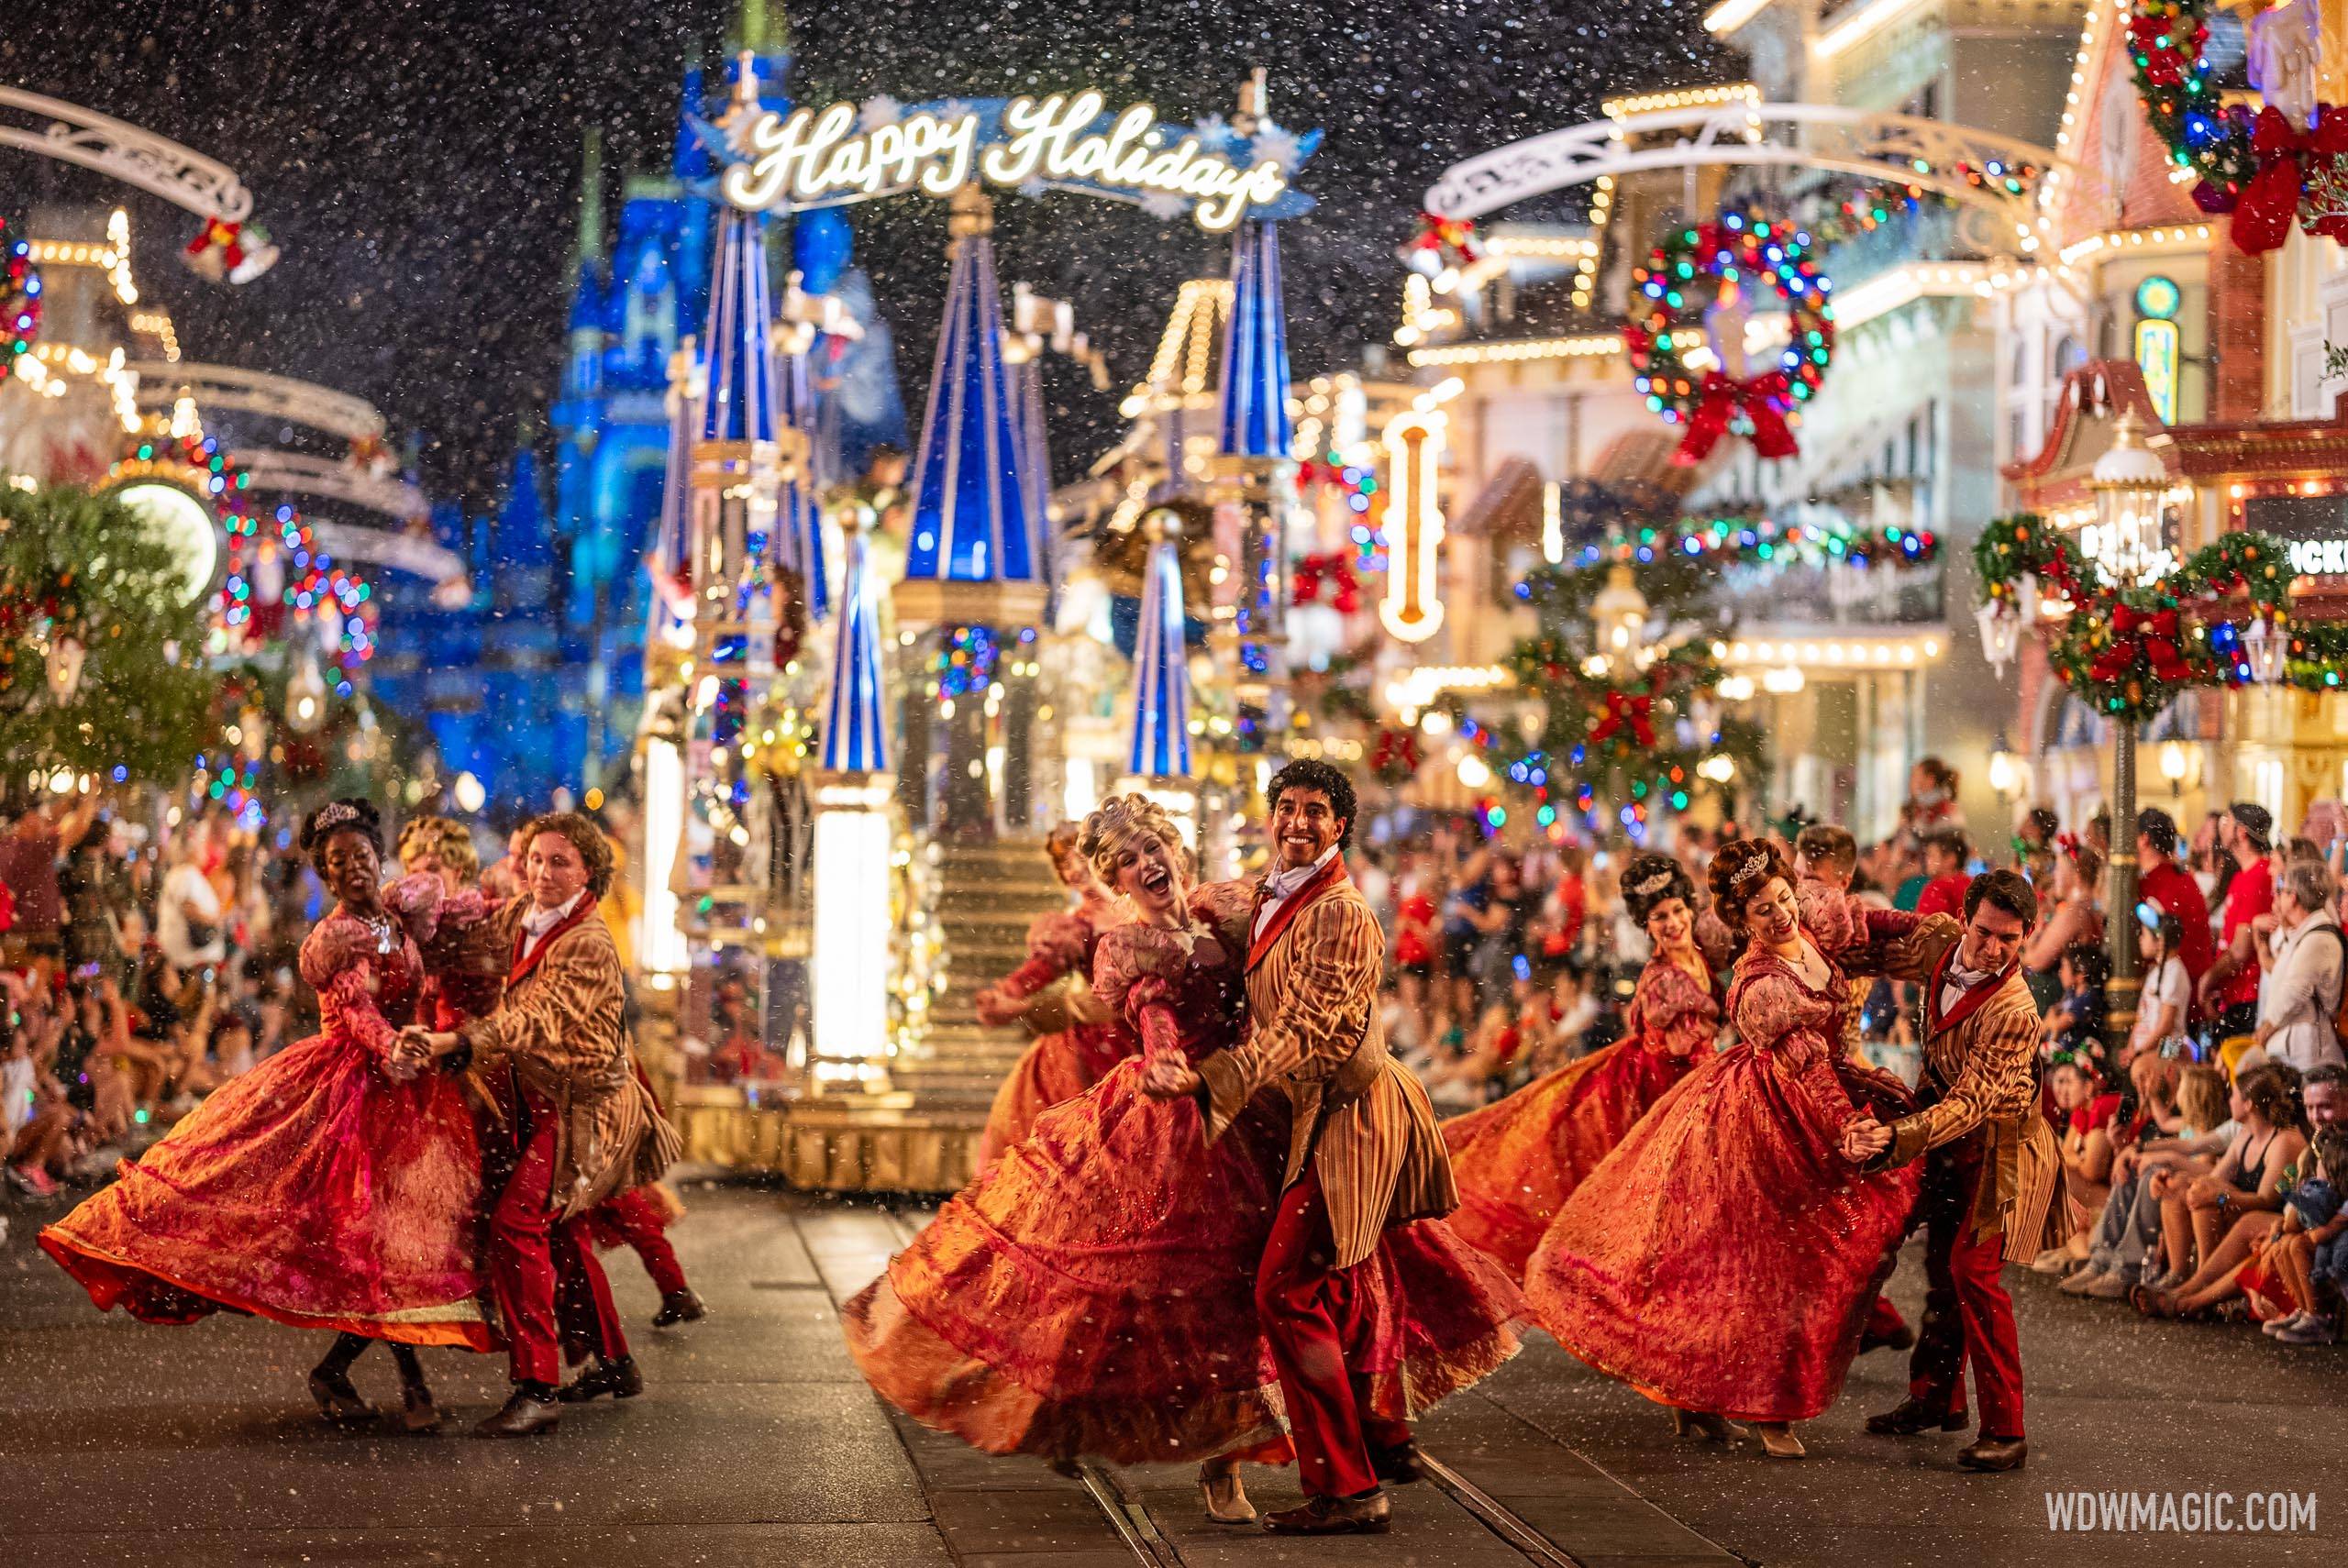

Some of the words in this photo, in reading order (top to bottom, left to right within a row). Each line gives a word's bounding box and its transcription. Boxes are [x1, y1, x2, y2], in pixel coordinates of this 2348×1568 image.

[727, 99, 979, 207] Happy
[984, 91, 1286, 230] Holidays
[2289, 539, 2348, 575] ICK
